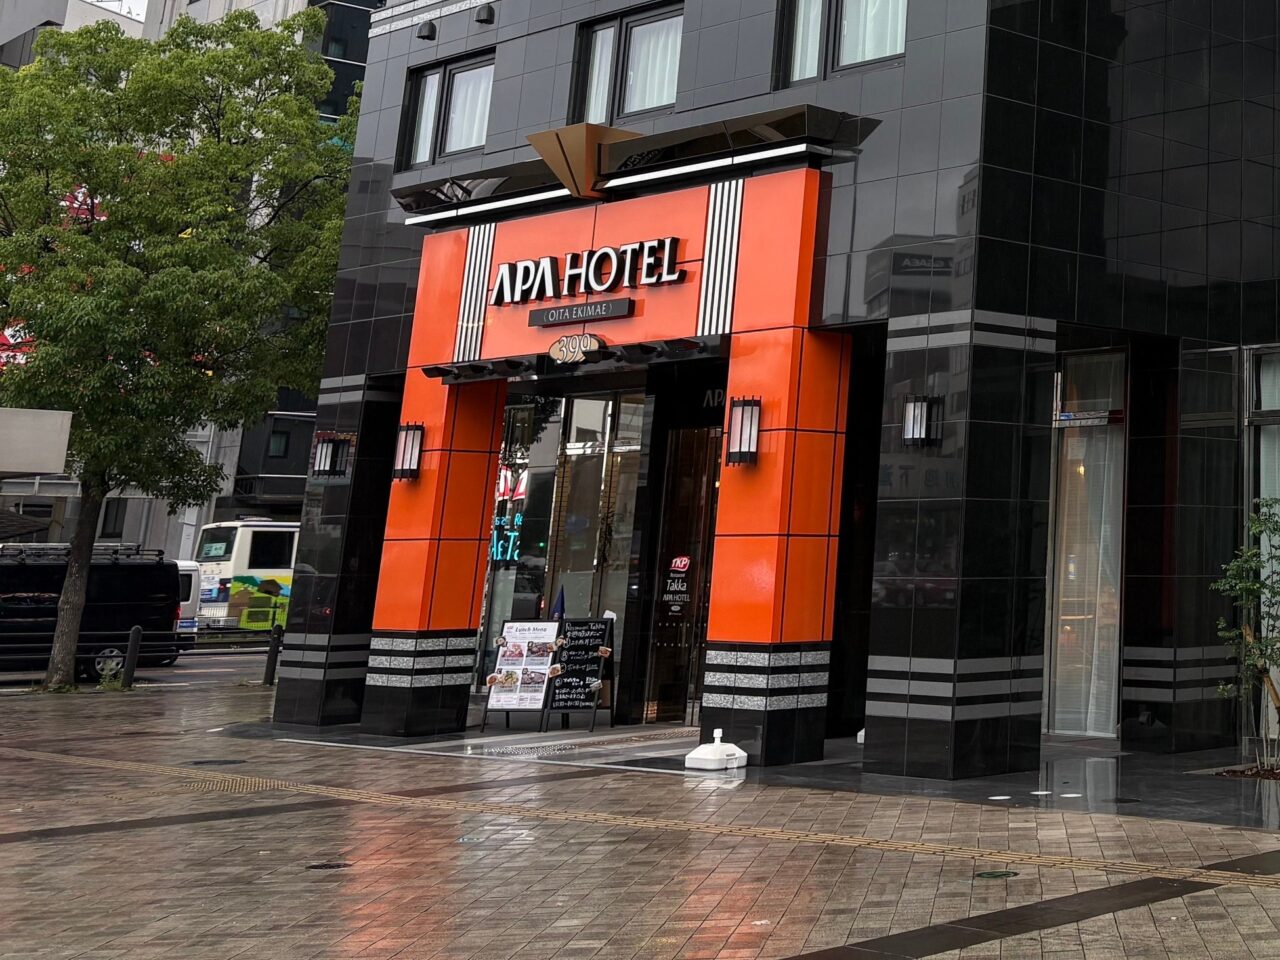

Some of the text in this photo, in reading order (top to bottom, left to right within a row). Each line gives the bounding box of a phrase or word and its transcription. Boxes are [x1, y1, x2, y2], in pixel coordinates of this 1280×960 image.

[489, 237, 684, 305] APA HOTEL
[671, 557, 688, 568] TKP
[666, 579, 687, 591] Takka
